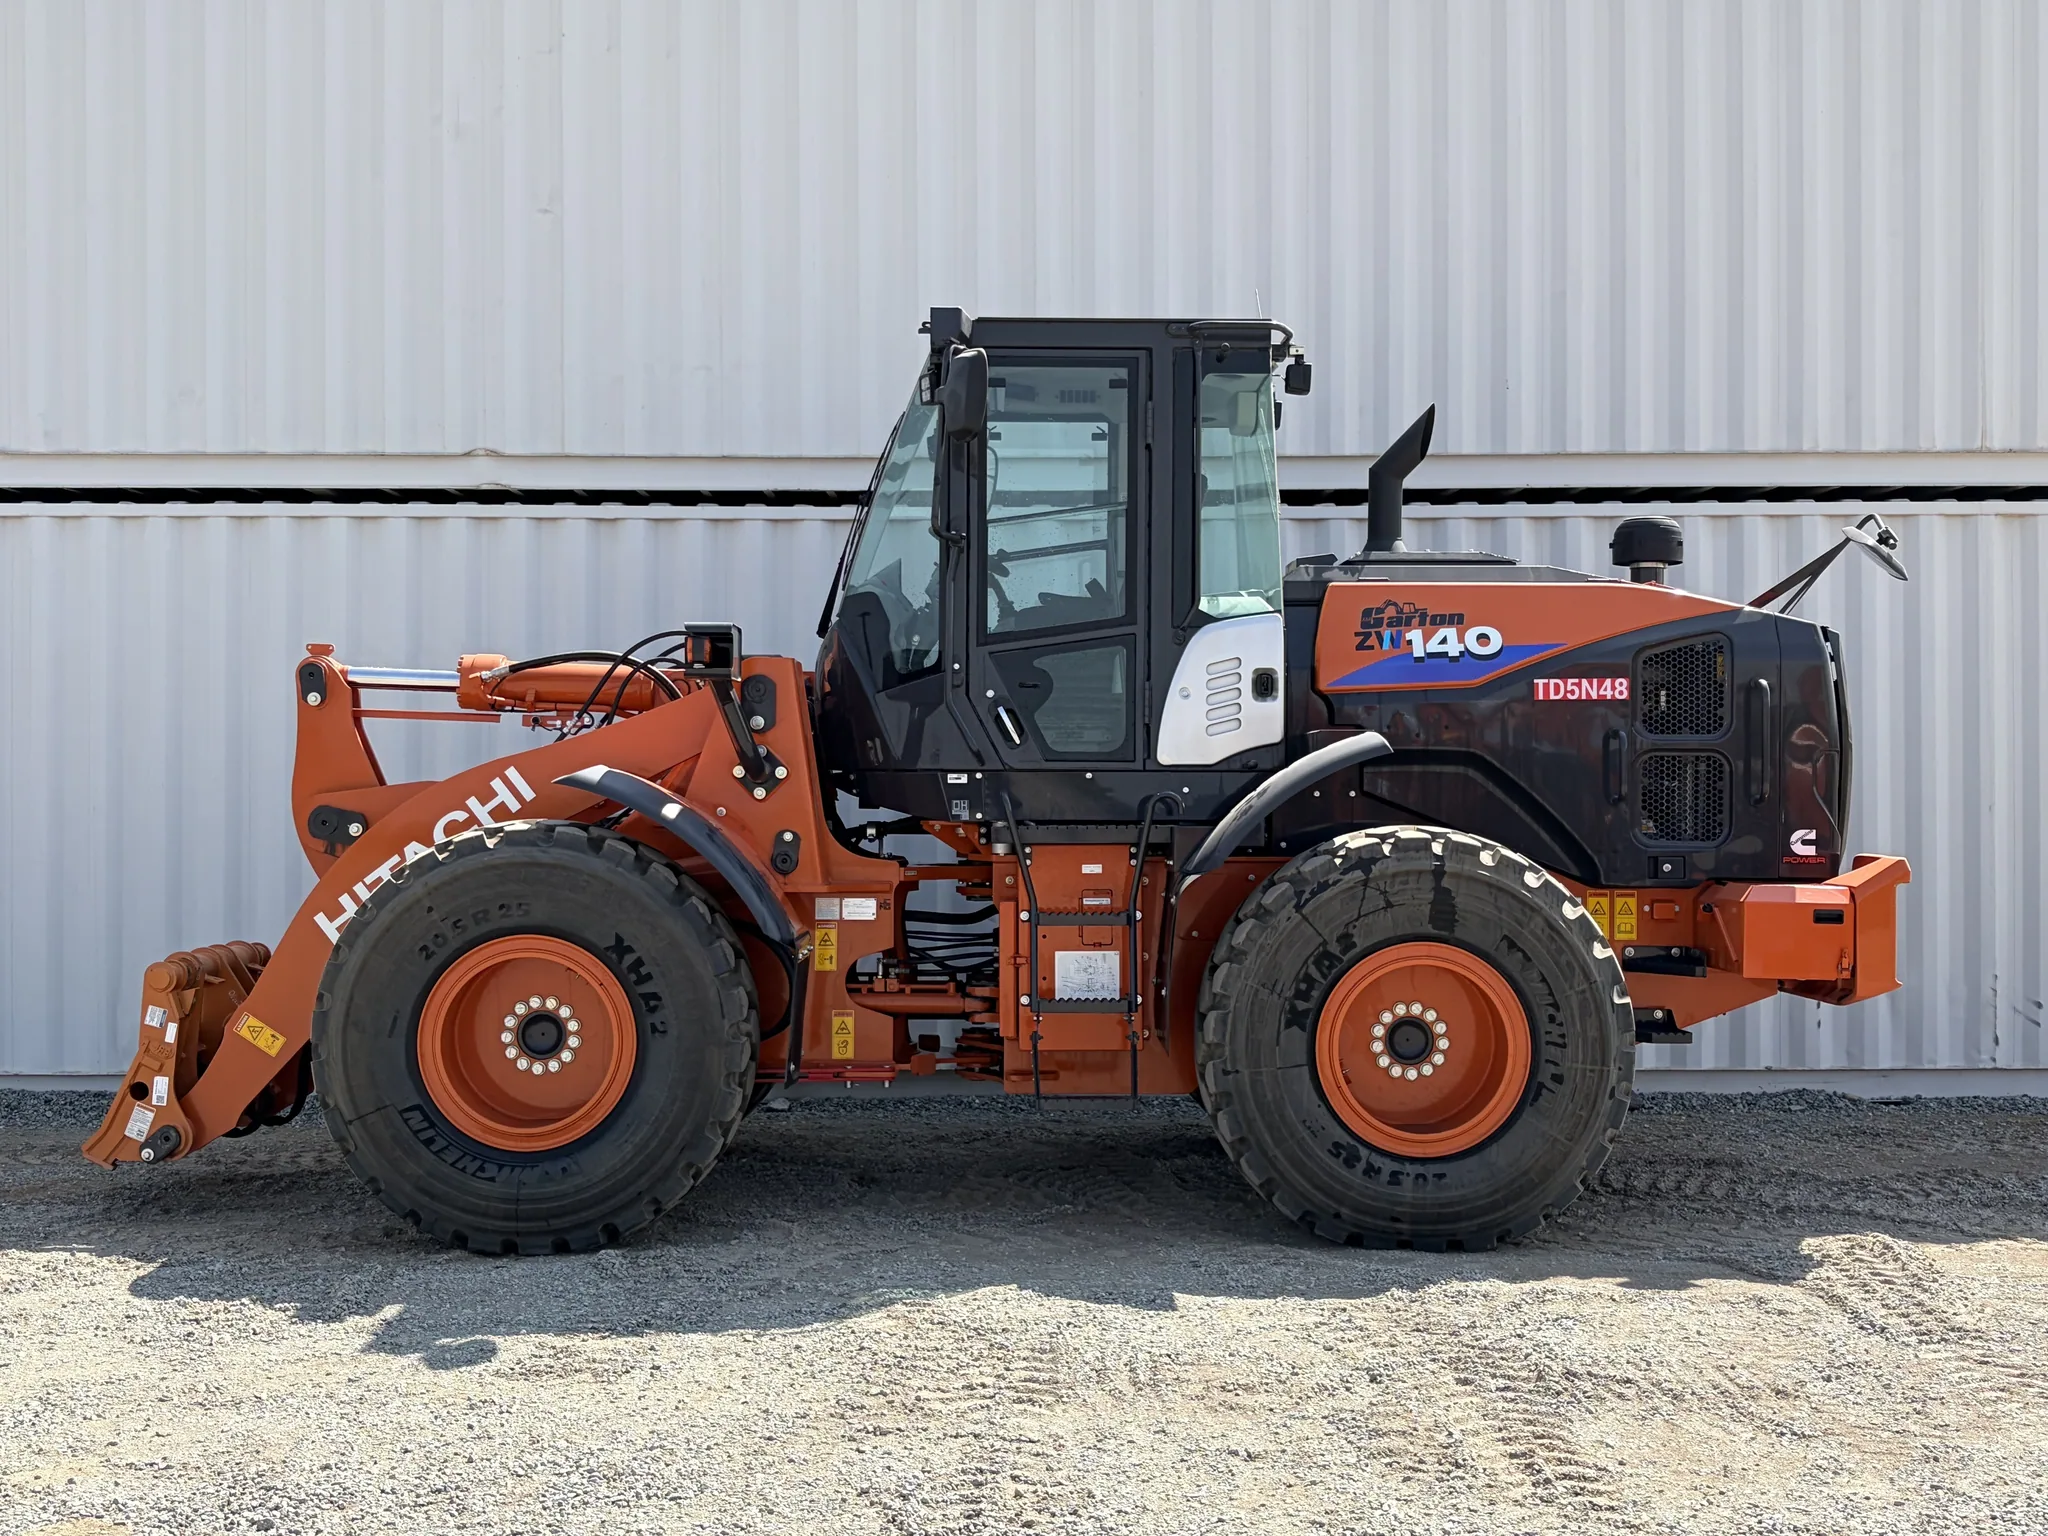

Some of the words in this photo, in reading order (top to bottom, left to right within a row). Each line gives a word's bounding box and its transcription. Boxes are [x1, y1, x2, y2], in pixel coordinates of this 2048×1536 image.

[1360, 606, 1465, 630] Garton
[1533, 677, 1629, 701] TD5N48
[1782, 856, 1826, 864] POWER
